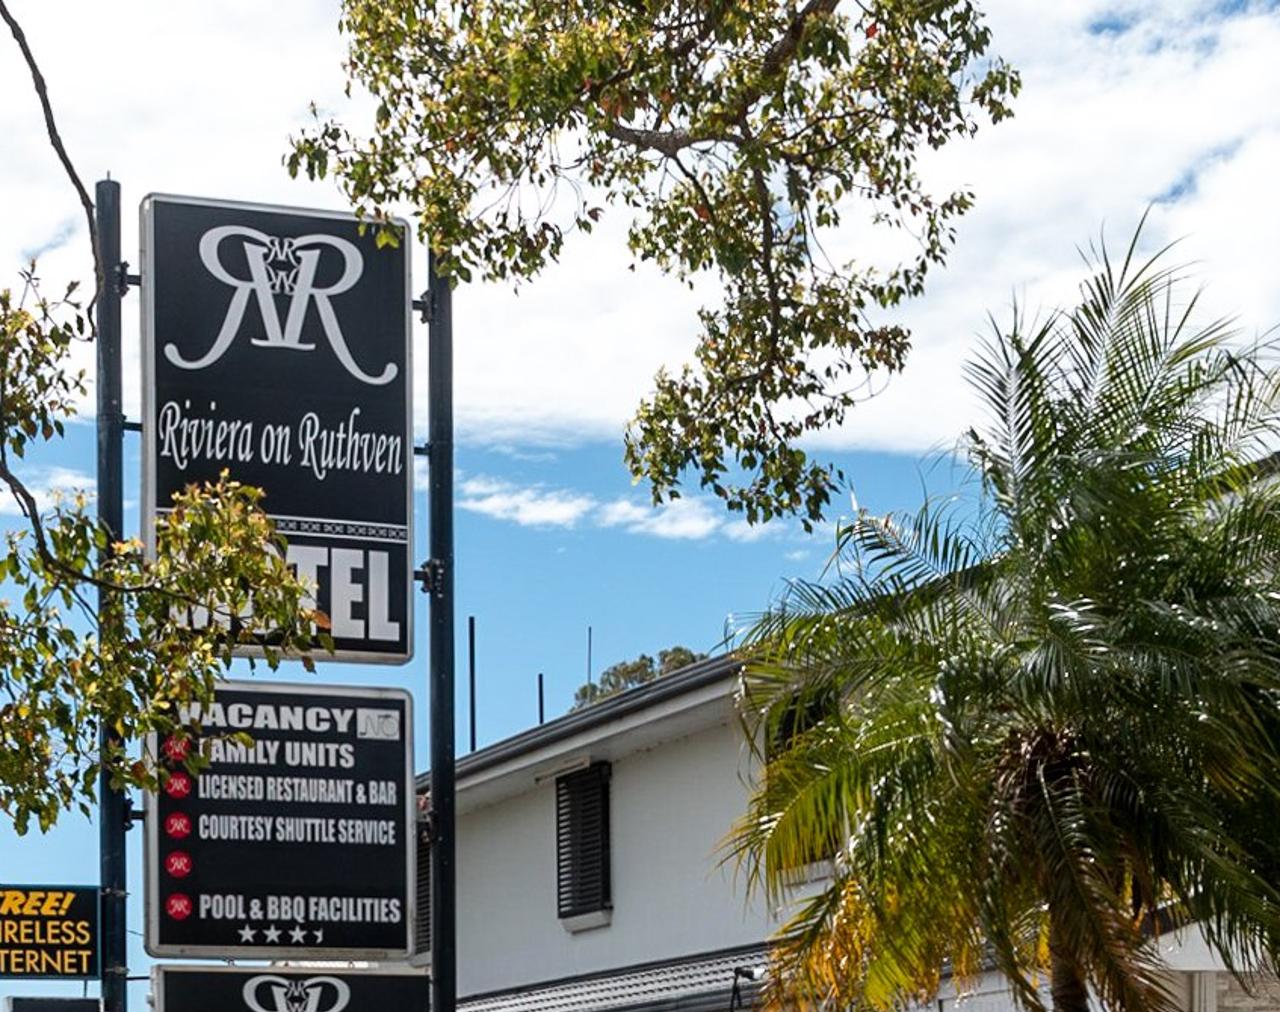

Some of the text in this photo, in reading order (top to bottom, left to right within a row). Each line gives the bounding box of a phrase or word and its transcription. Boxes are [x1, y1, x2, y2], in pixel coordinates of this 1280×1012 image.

[159, 400, 403, 480] Riviera on Ruthven
[169, 539, 401, 641] TEL
[176, 701, 354, 733] VACANCY
[285, 741, 355, 768] UNITS
[198, 774, 264, 800] LICENSED
[266, 776, 354, 803] RESTAURANT
[356, 783, 367, 804] &
[369, 780, 397, 805] BAR
[198, 814, 273, 841] COURTESY
[275, 816, 336, 842] SHUTTLE
[337, 819, 396, 845] SERVICE
[199, 894, 246, 920] POOL
[250, 898, 263, 920] &
[267, 896, 305, 923] BBQ
[308, 897, 401, 923] FACILITIES
